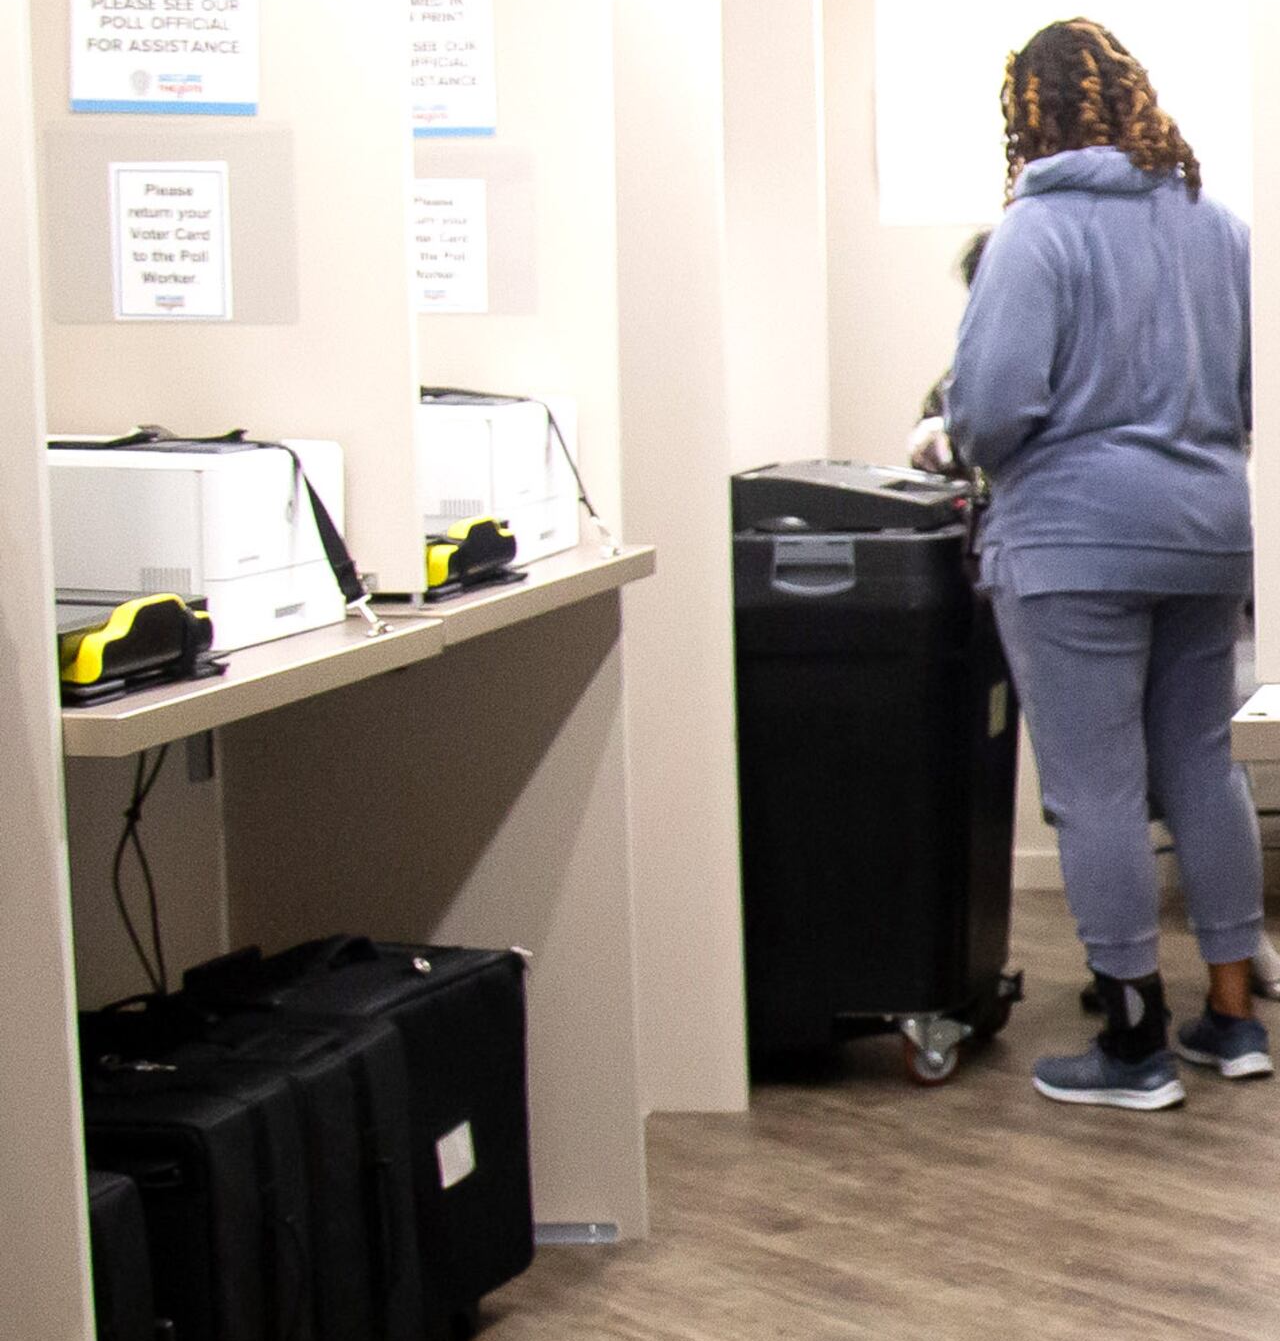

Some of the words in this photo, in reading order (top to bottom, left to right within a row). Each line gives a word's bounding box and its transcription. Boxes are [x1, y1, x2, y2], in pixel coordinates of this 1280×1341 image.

[99, 15, 145, 31] POLL
[150, 16, 230, 32] OFFICIAL
[87, 37, 122, 53] FOR
[128, 38, 242, 56] ASSISTANCE
[144, 183, 195, 197] Please
[177, 208, 213, 222] your
[130, 227, 171, 240] Voter
[175, 228, 212, 241] Card
[132, 250, 149, 262] to
[151, 251, 176, 263] the
